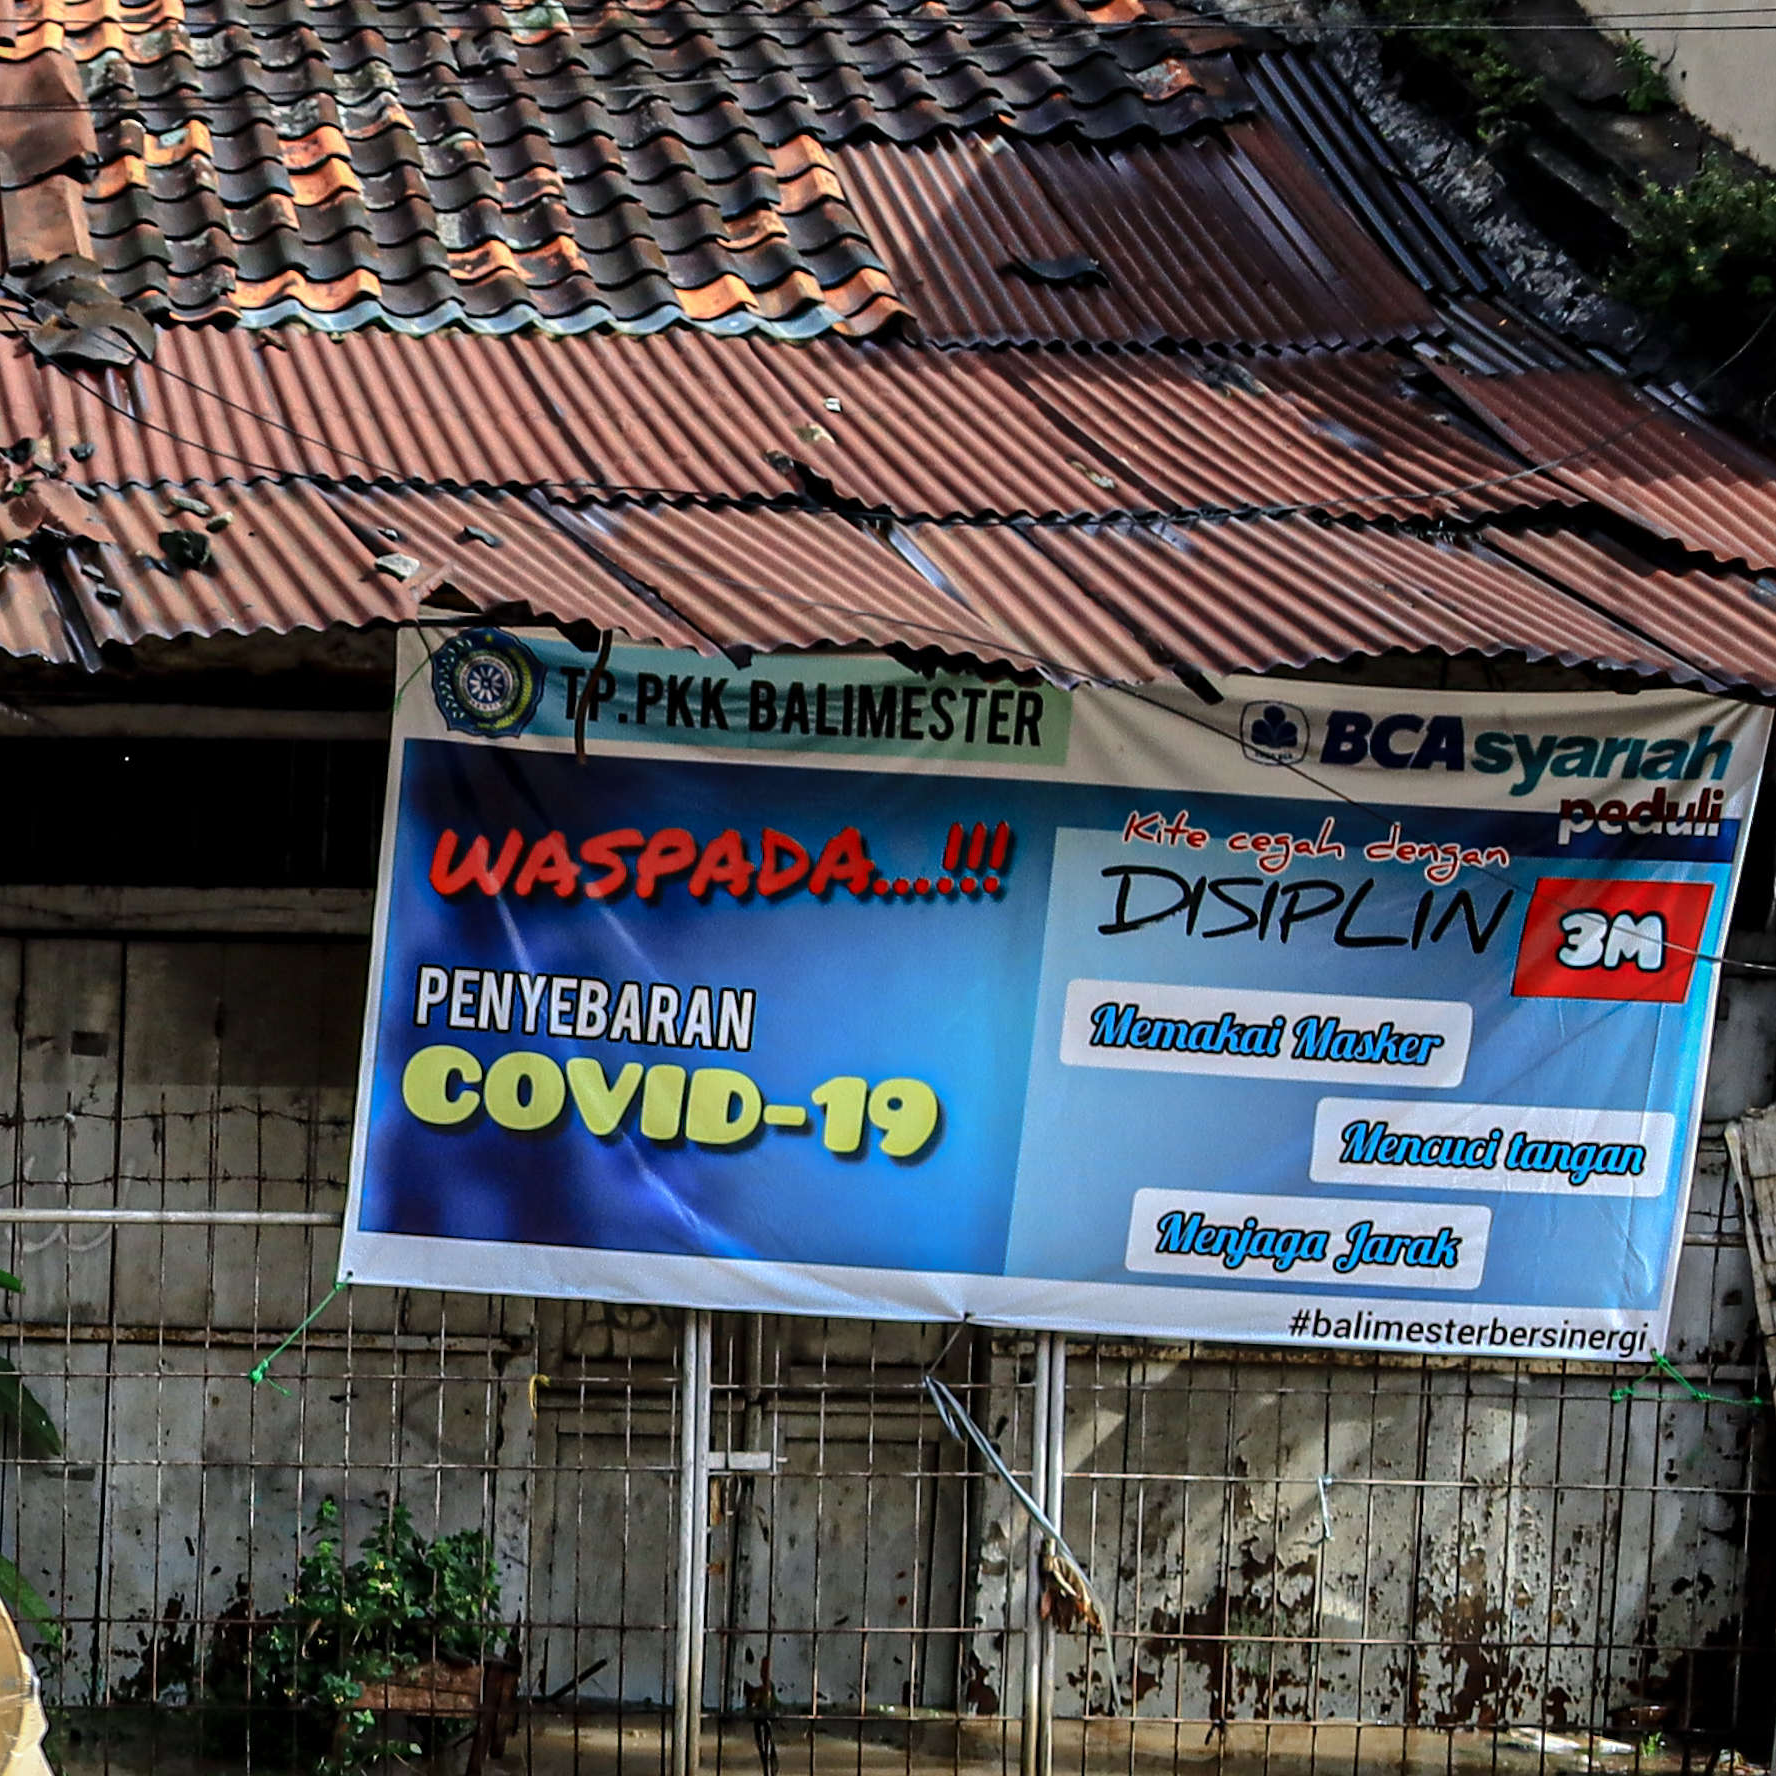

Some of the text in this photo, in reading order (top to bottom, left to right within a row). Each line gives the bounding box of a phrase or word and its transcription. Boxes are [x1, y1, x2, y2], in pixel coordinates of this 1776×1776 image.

[748, 680, 1045, 748] BALIMESTER
[1557, 787, 1726, 846] peduli
[1226, 816, 1346, 875] cegah
[1364, 821, 1511, 886] dengan
[1097, 864, 1515, 955] DISIPLIN
[1556, 907, 1667, 973] 3M
[413, 964, 756, 1053] PENYEBARAN
[1089, 1001, 1445, 1067] Memakai Masker
[401, 1044, 940, 1159] COVID-19
[1339, 1121, 1647, 1187] Mencuci tangan
[1156, 1210, 1463, 1273] Menjaga Jarak
[1288, 1307, 1649, 1355] #balimesterbersinergi
